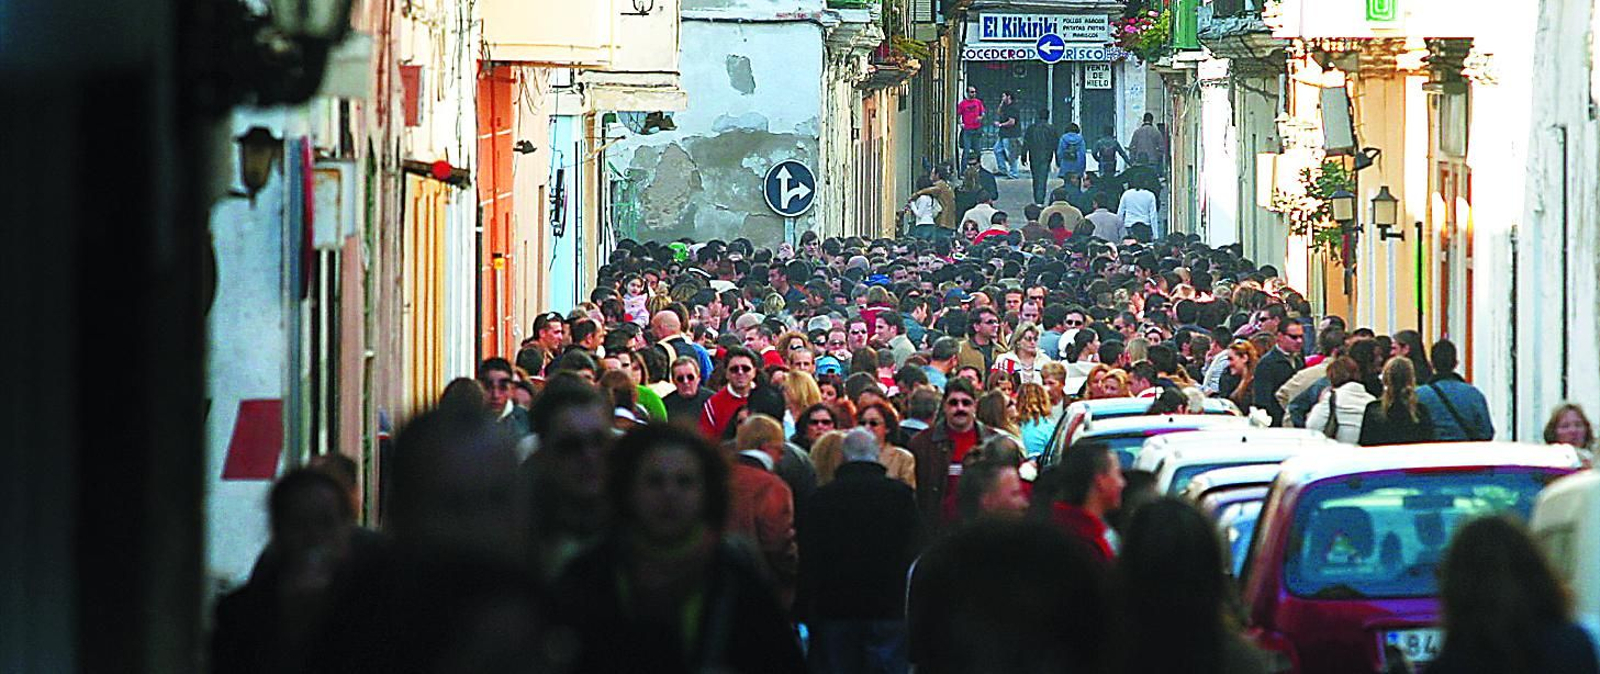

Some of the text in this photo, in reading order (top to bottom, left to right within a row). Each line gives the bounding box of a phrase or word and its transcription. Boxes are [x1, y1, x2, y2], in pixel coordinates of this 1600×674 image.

[984, 16, 998, 38] El
[1062, 48, 1104, 60] RISCO
[1087, 79, 1109, 87] HIELO
